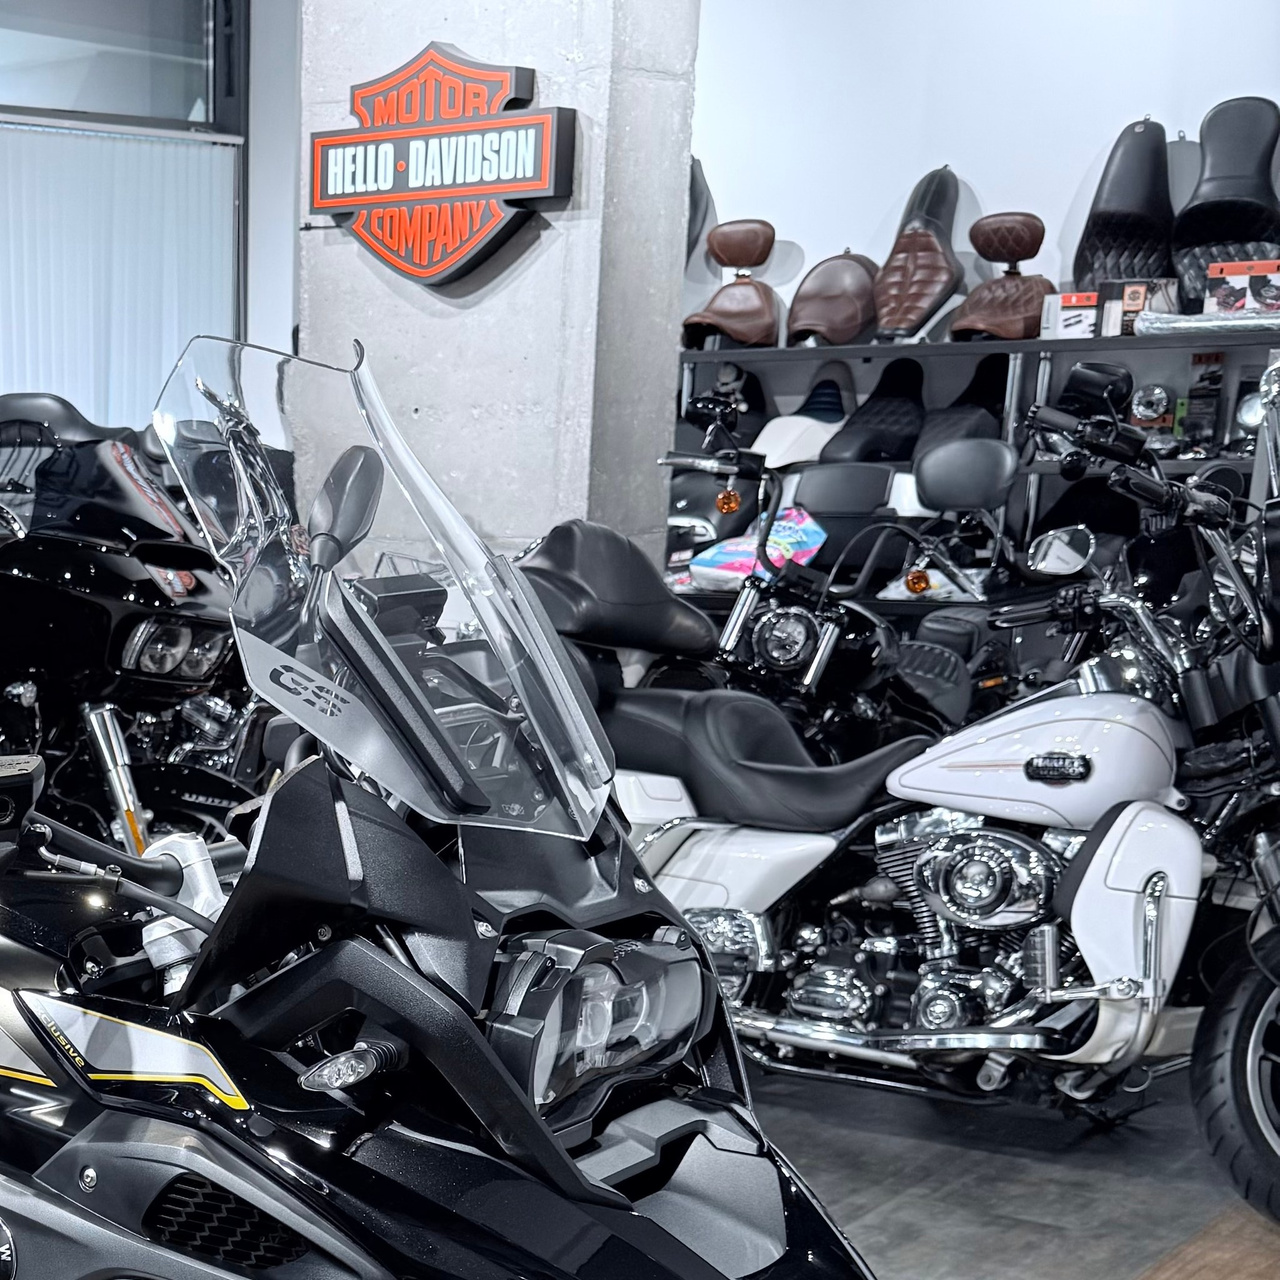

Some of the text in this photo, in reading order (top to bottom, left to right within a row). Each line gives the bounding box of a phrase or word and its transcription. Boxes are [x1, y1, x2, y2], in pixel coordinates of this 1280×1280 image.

[373, 66, 489, 127] MOTOR
[327, 128, 536, 195] HELLO DAVIDSON
[370, 200, 486, 266] COMPANY
[269, 664, 351, 718] GS
